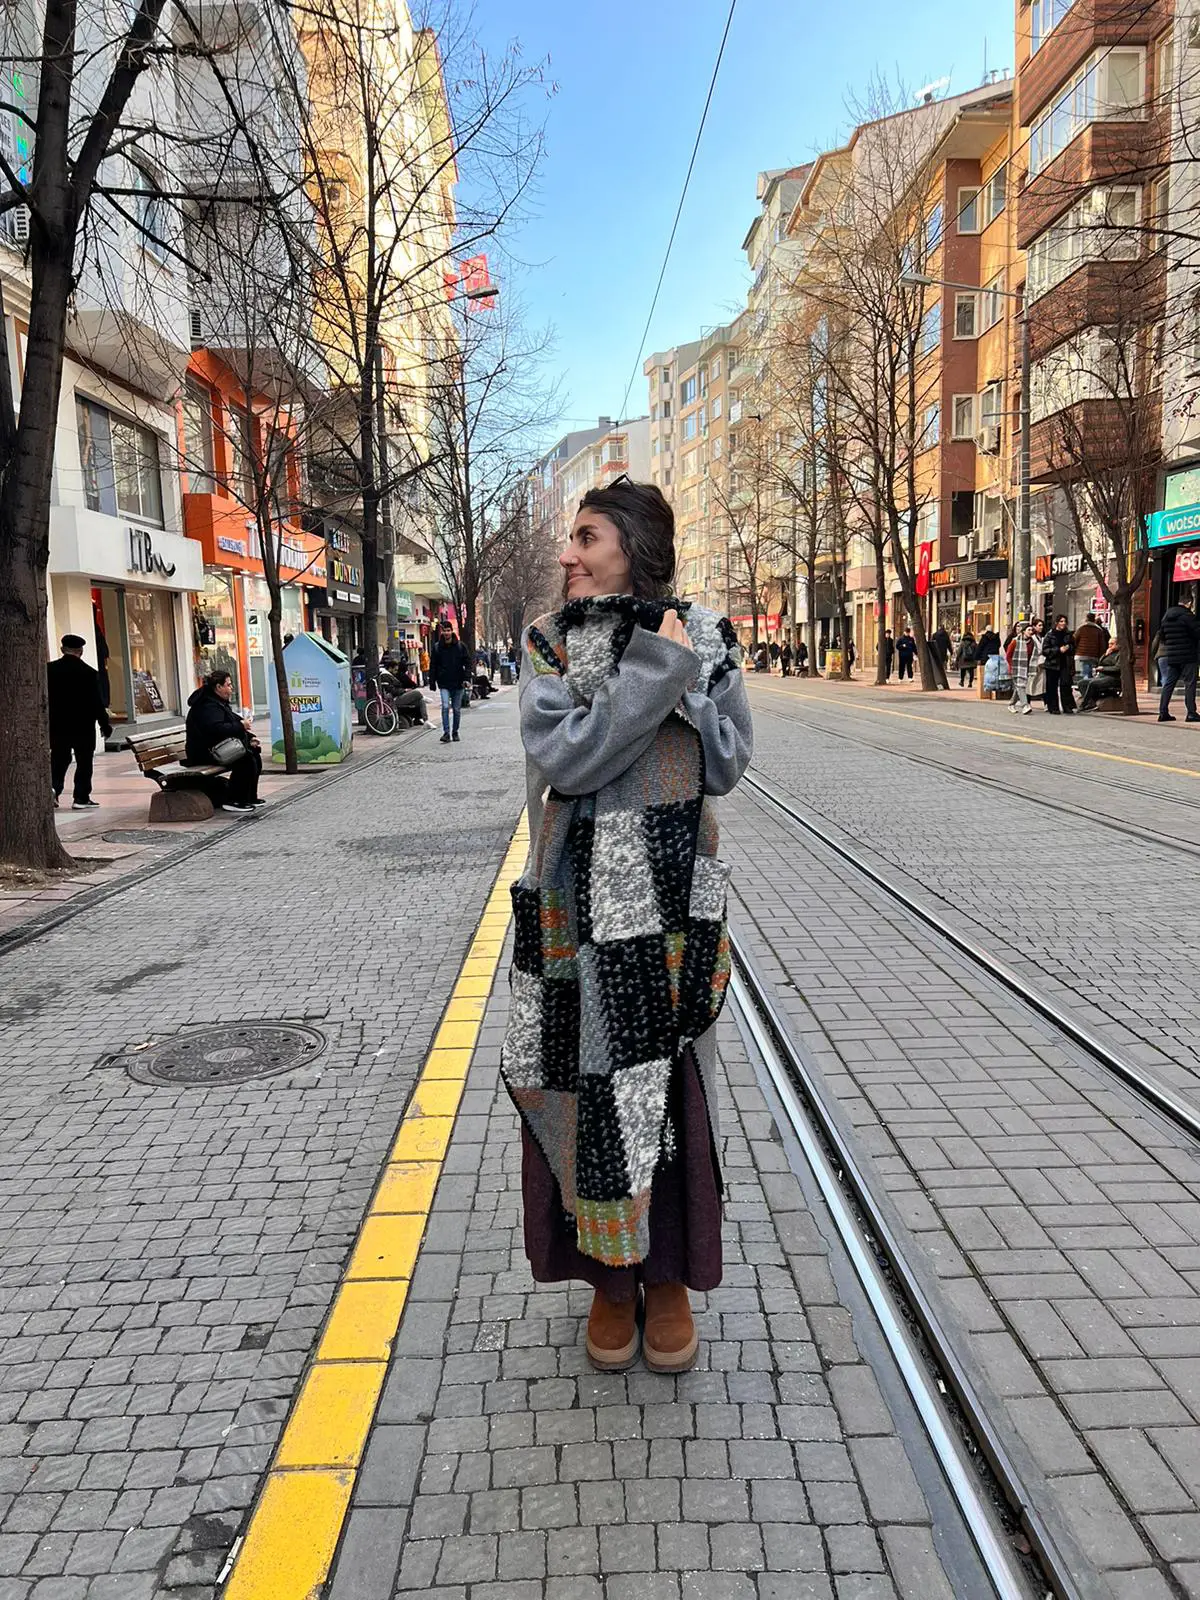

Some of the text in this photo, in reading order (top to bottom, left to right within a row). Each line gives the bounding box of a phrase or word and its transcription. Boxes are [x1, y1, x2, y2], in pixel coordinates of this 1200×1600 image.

[129, 527, 153, 573] LTB
[1036, 554, 1083, 582] IN STREET
